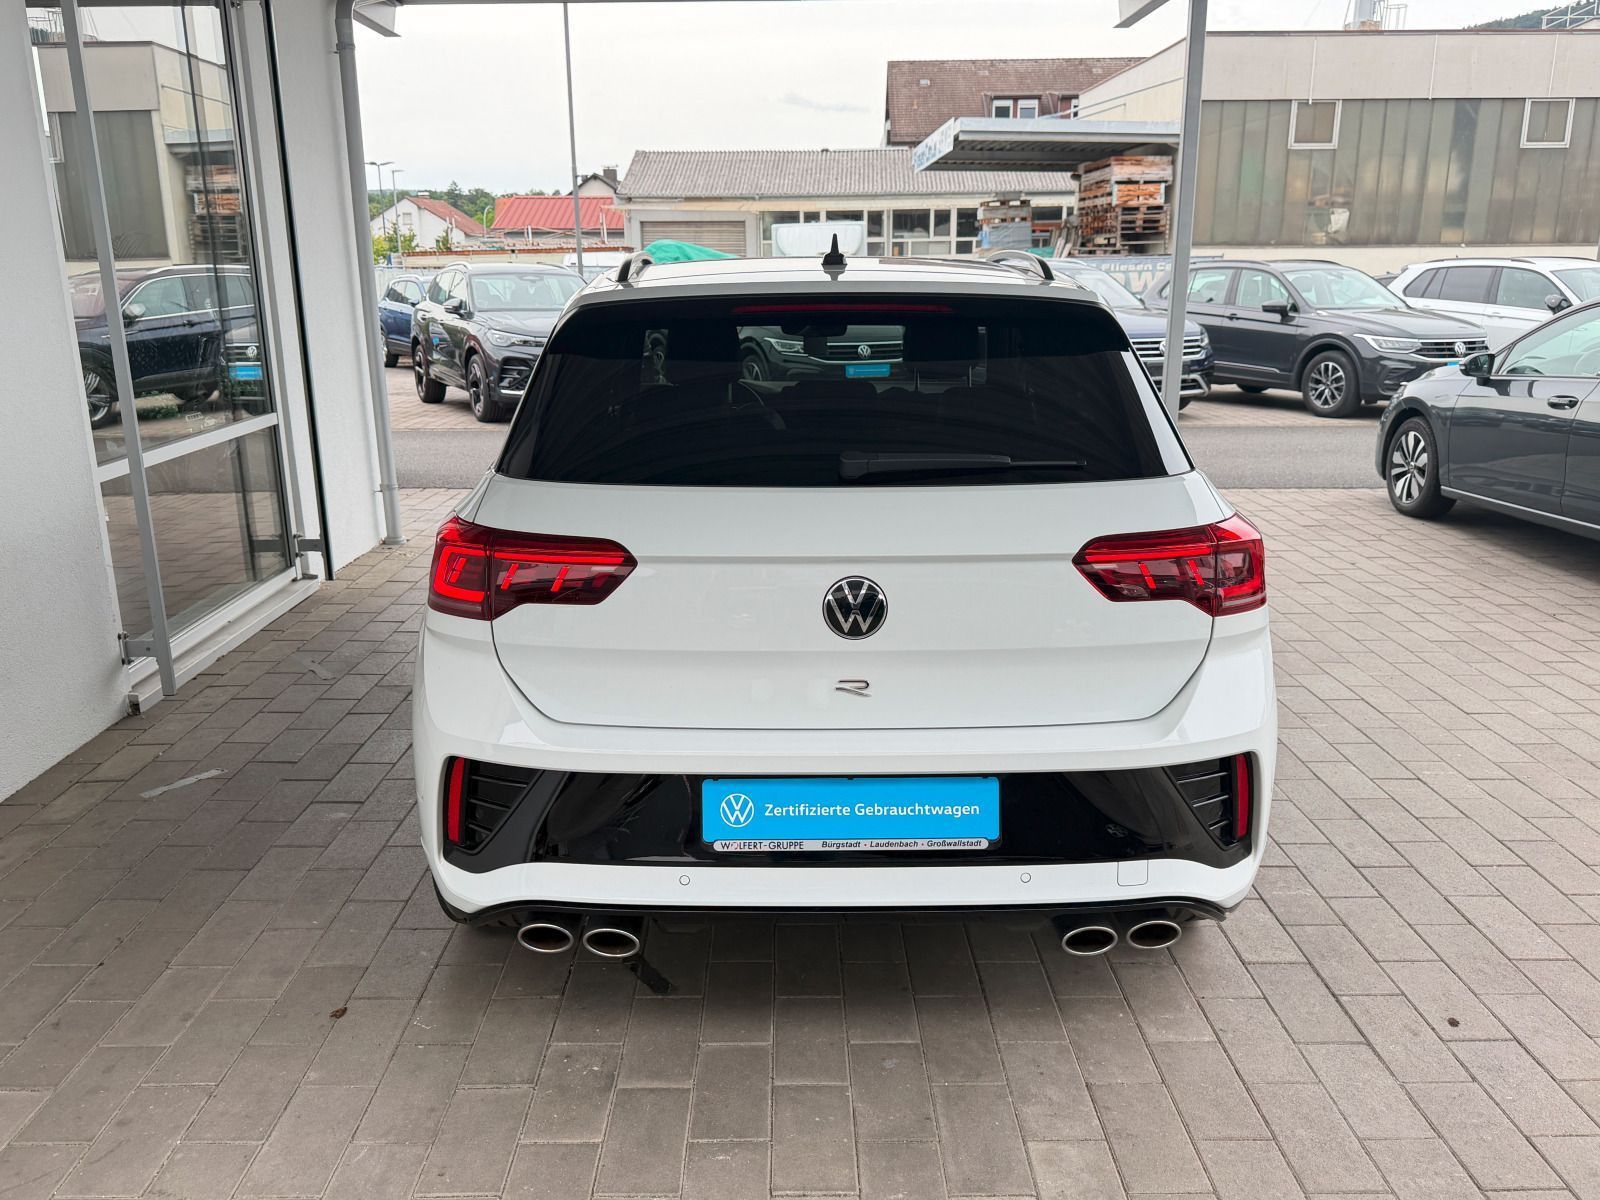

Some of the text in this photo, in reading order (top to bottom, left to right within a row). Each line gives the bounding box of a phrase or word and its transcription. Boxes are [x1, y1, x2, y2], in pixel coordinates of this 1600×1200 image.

[822, 575, 889, 641] VW
[720, 793, 755, 828] VW
[764, 803, 980, 818] Zertifizierte Gebrauchtwagen
[720, 841, 805, 850] WOLFERT-GRUPPE
[821, 839, 982, 849] Bürgstadt Laudenbach Großwallstadt
